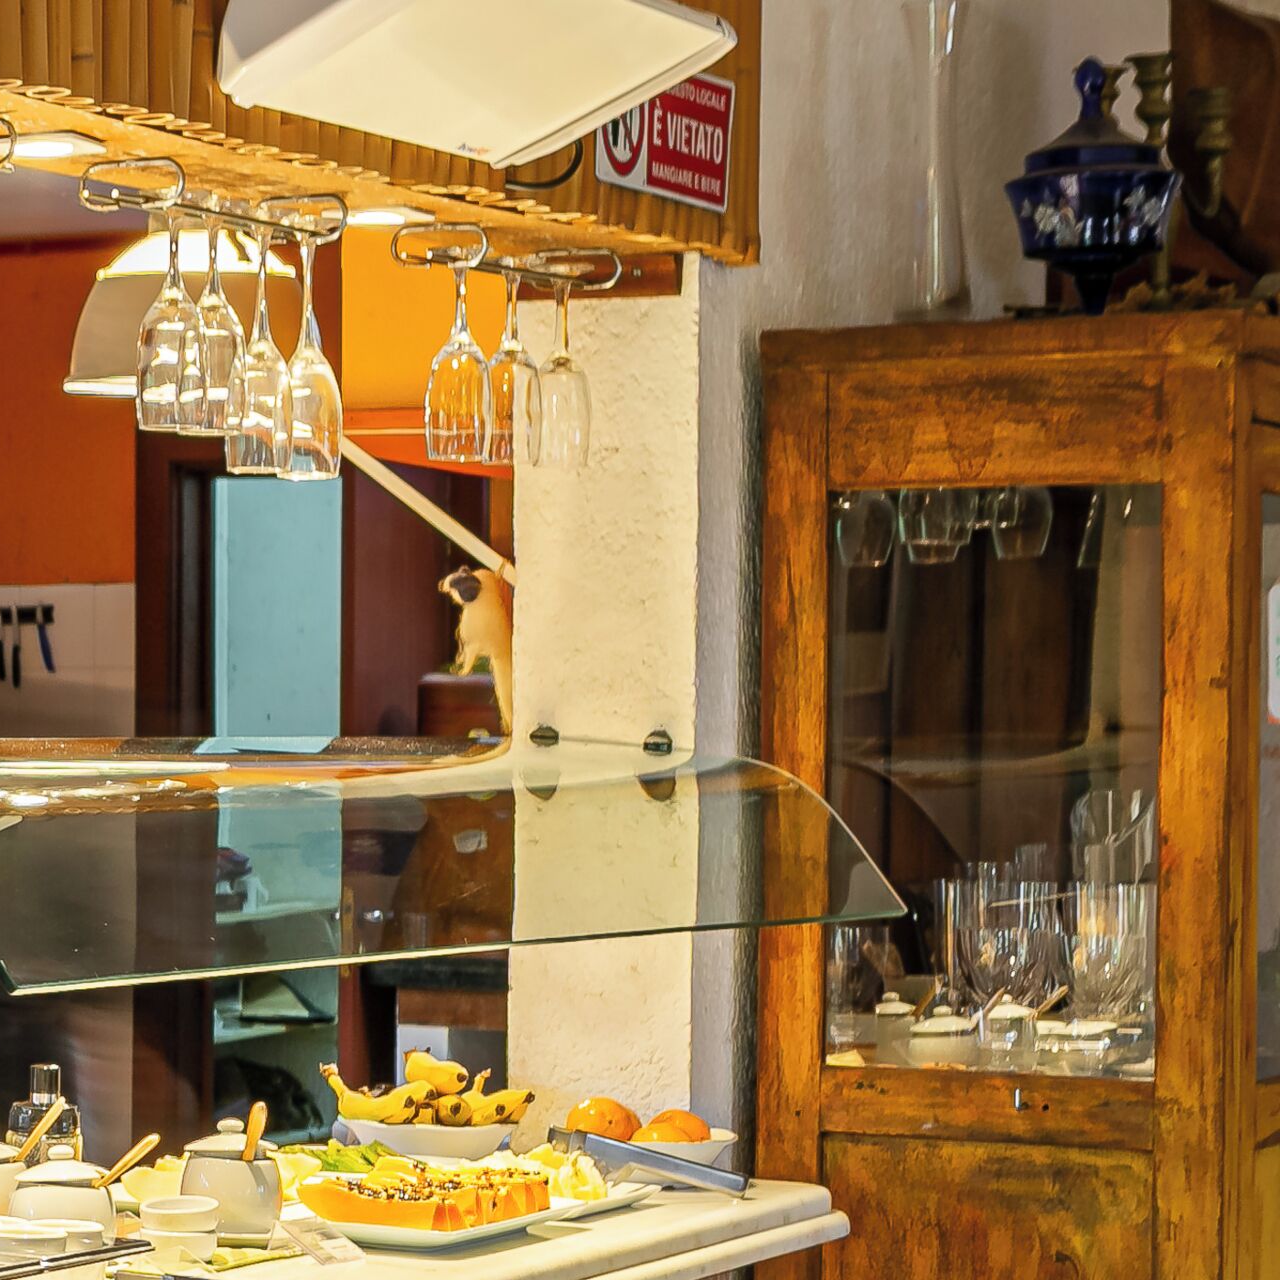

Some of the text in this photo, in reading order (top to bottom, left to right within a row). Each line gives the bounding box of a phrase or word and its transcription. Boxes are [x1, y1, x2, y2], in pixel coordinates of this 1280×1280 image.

[666, 82, 726, 112] UESTO LOCALE
[653, 98, 723, 165] È VIETATO
[652, 160, 720, 196] MANGIARE E BERE
